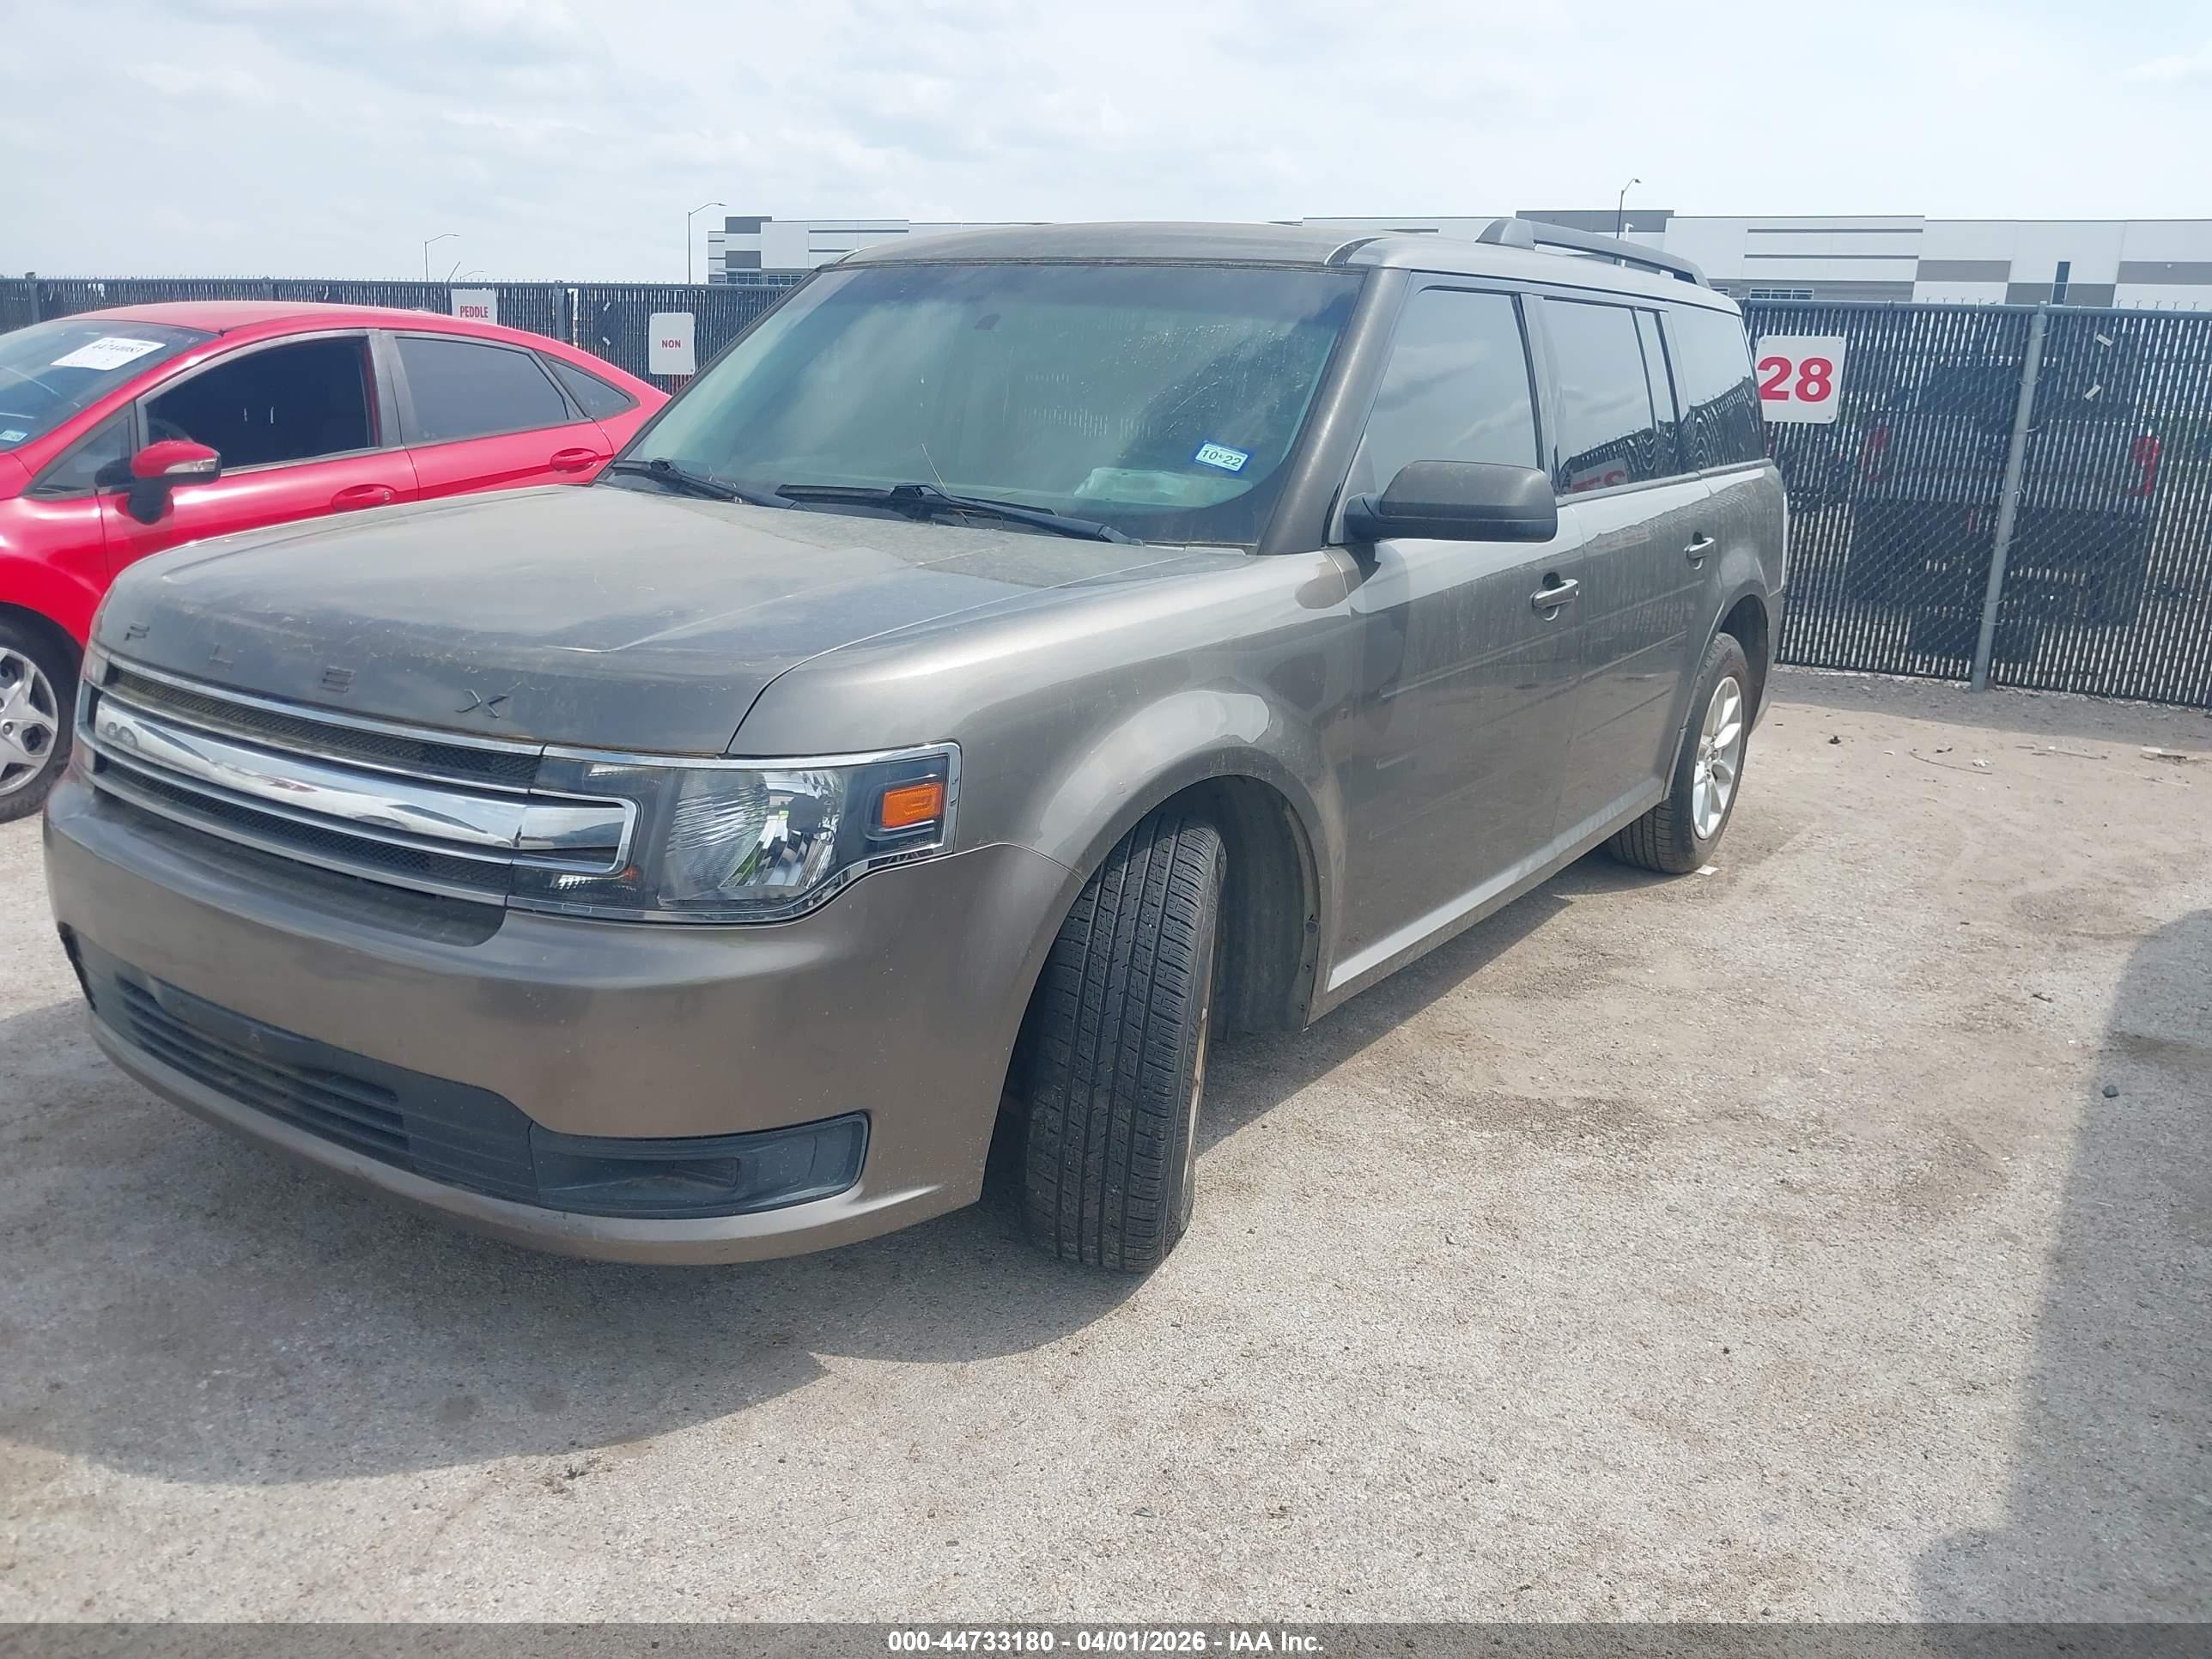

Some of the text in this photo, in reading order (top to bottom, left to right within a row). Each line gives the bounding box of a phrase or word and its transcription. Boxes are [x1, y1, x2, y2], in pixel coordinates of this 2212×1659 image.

[459, 305, 489, 319] PEDDLE
[661, 339, 681, 349] NON
[1757, 356, 1832, 402] 28
